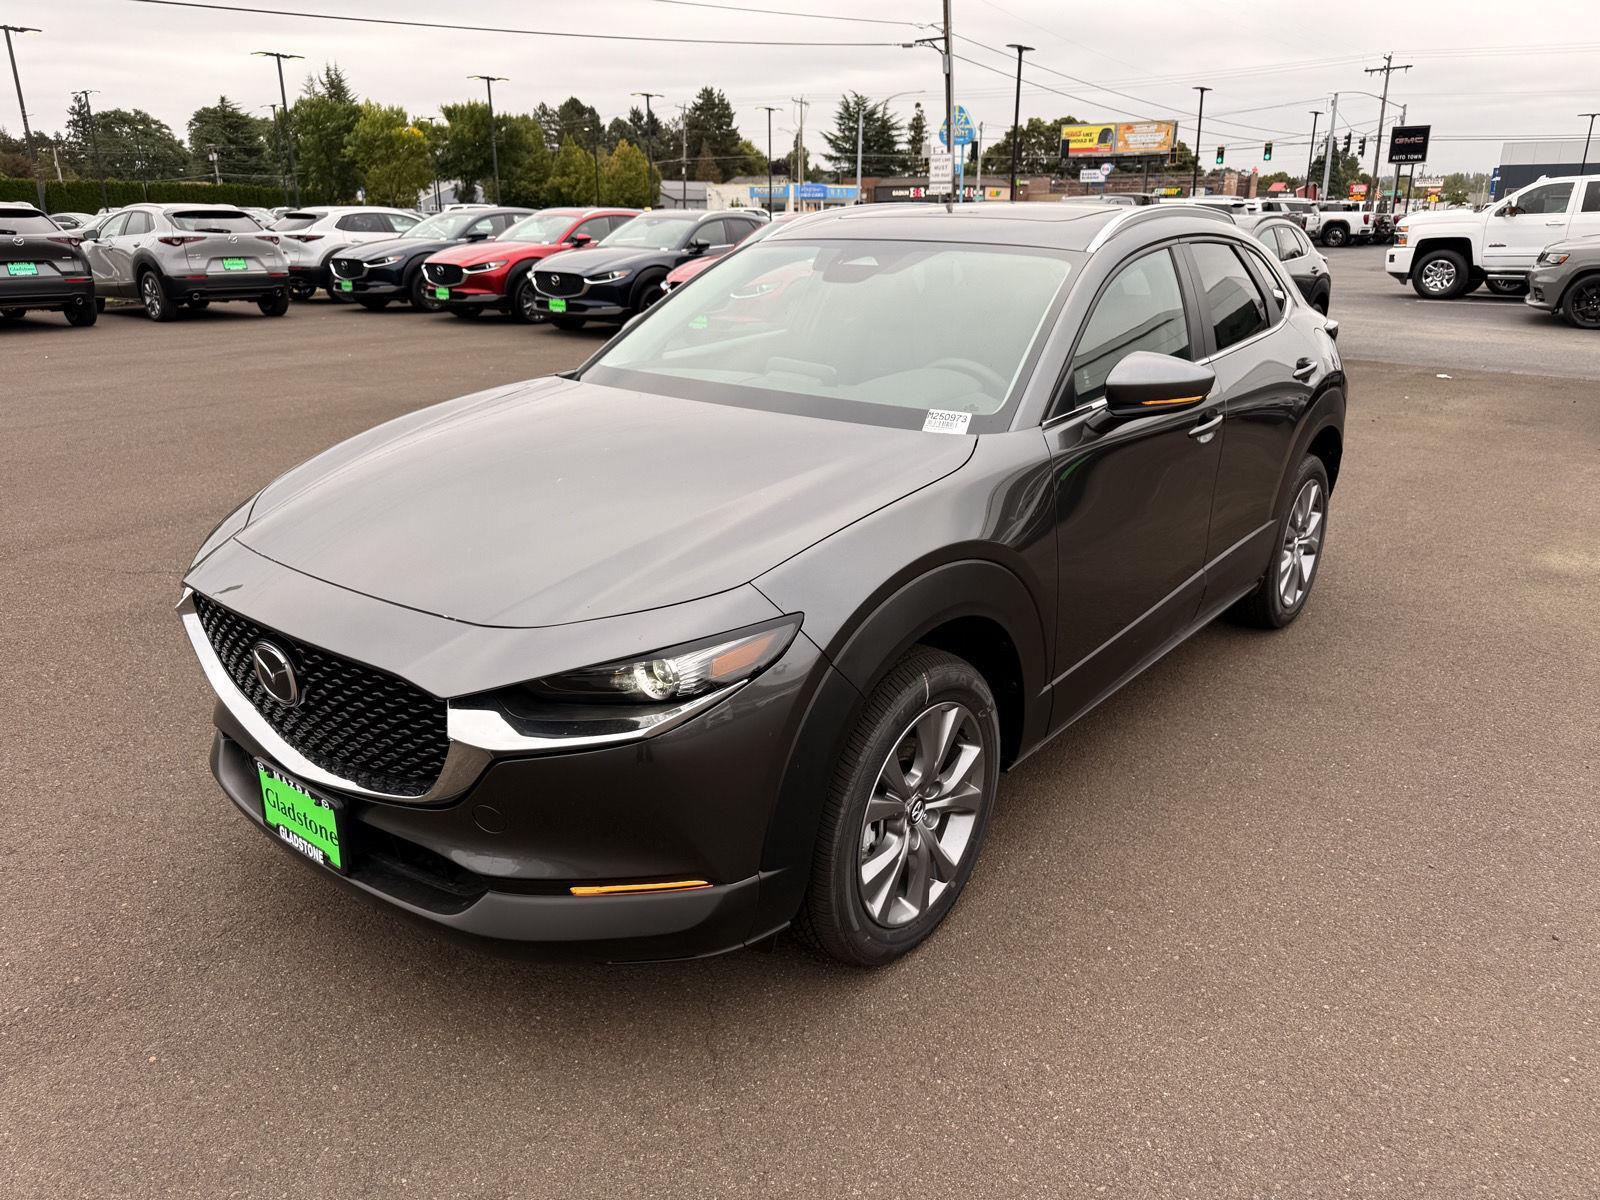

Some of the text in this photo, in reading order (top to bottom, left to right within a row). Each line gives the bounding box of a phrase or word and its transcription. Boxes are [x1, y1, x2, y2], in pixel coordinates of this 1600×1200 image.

[927, 411, 968, 423] M250973
[273, 770, 311, 800] MAZDA
[265, 788, 339, 846] Gladstone
[279, 825, 325, 865] GLADSTONE
